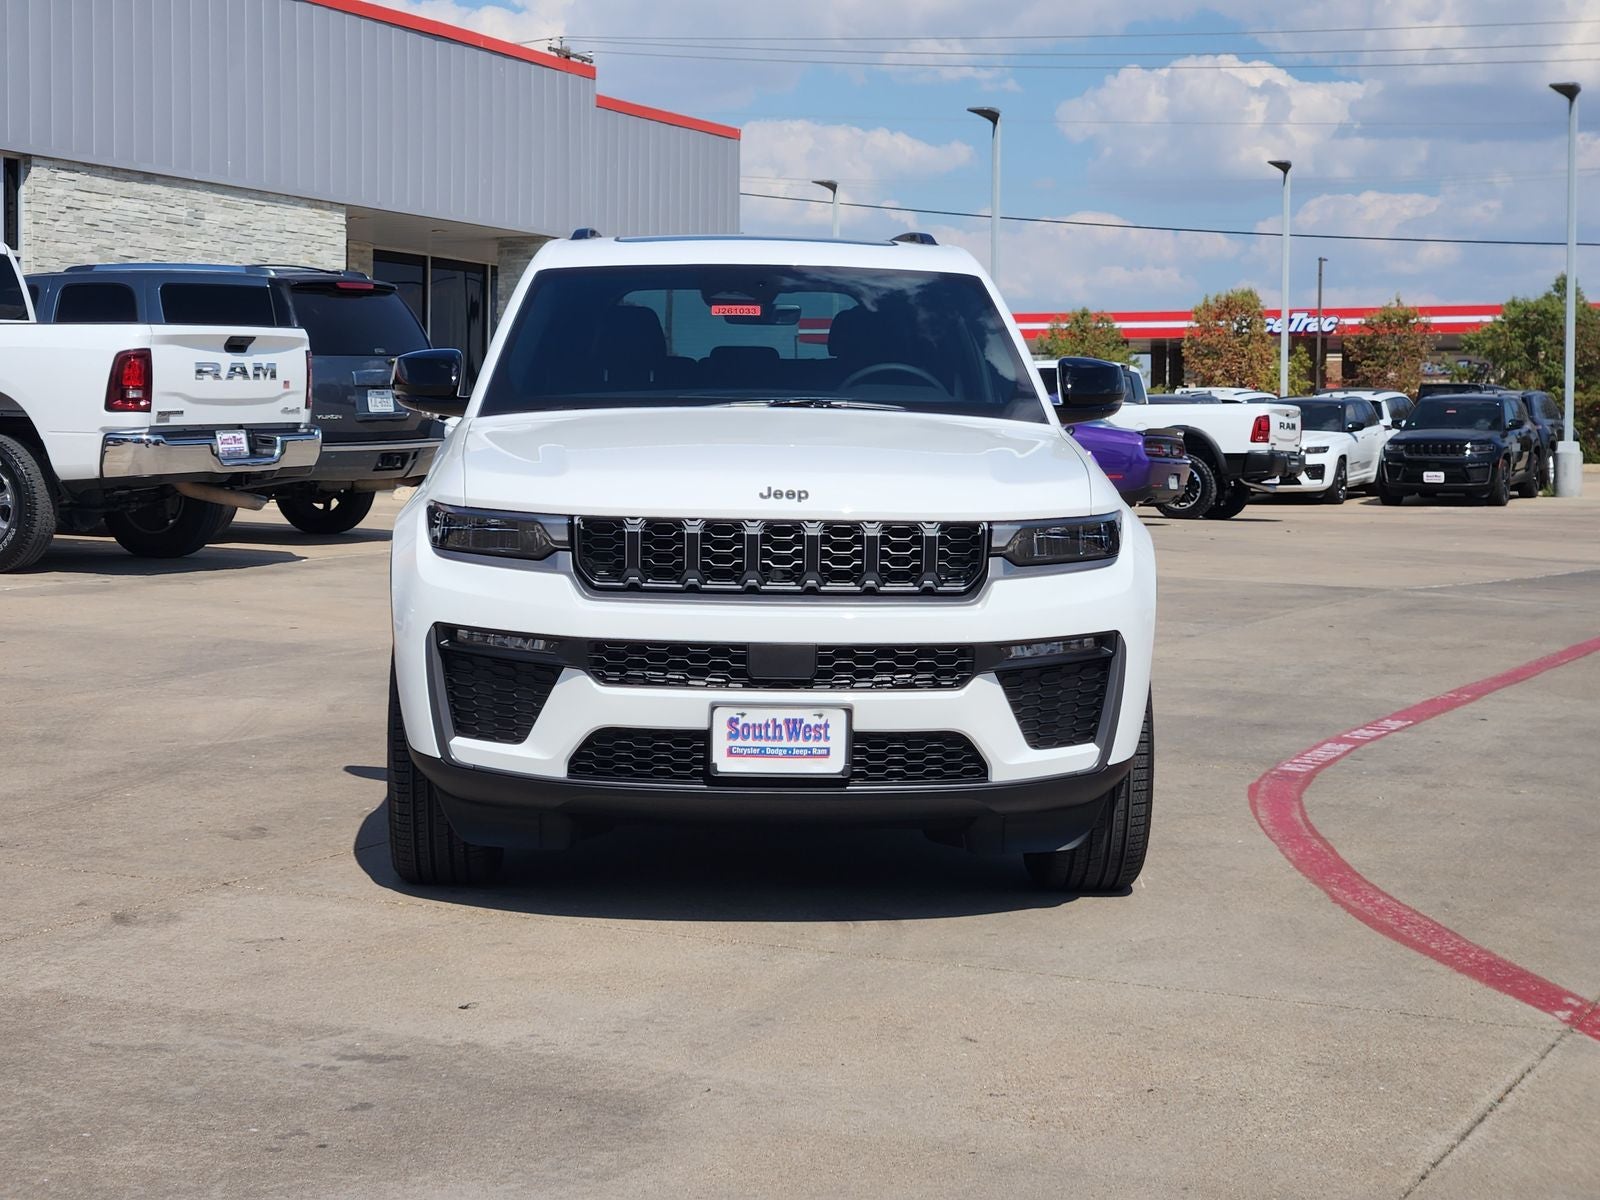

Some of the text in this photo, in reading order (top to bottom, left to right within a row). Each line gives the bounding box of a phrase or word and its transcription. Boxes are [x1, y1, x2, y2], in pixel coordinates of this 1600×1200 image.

[714, 307, 757, 315] J261033
[195, 361, 277, 381] RAM
[1279, 421, 1296, 431] RAM
[758, 486, 809, 503] Jeep
[726, 716, 831, 743] SouthWest
[732, 747, 827, 756] Chrysler Dodge Jeep Ram
